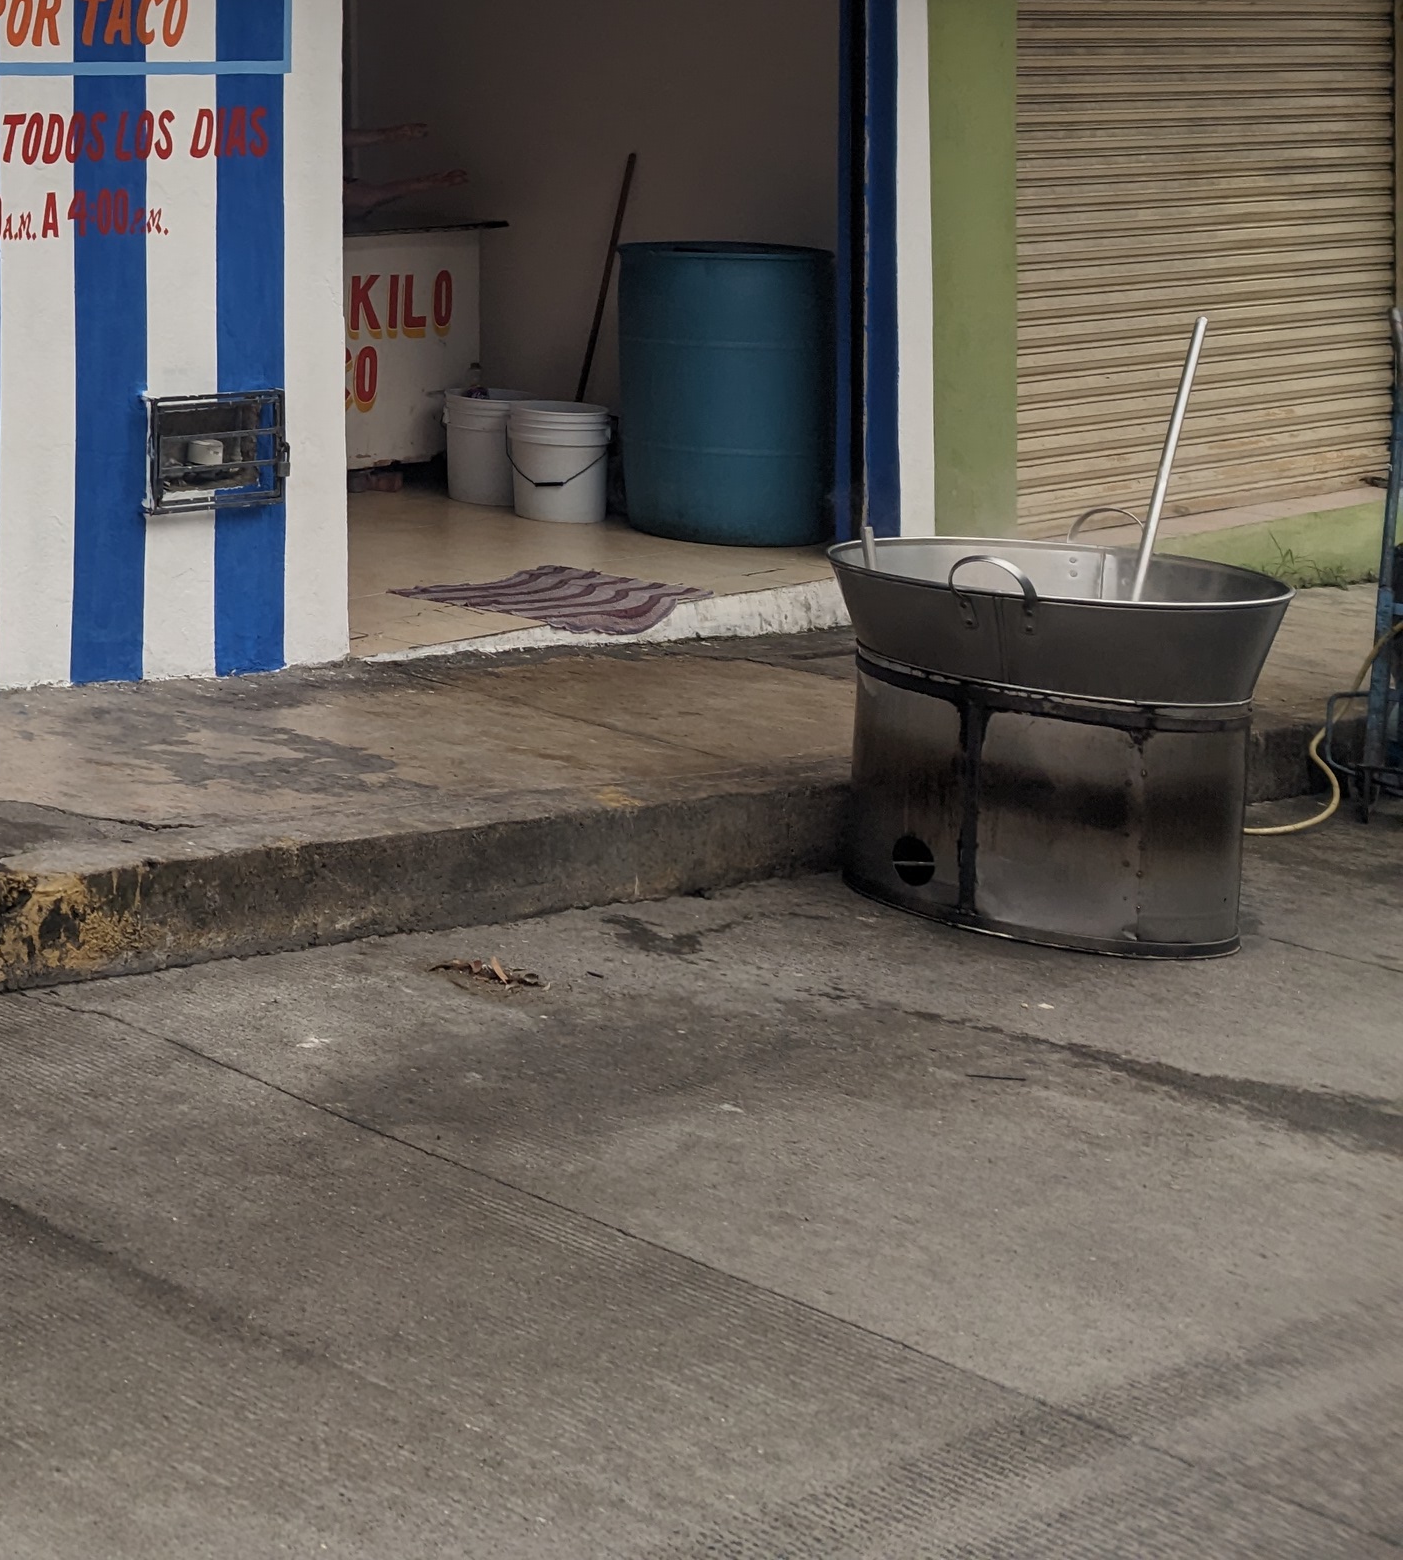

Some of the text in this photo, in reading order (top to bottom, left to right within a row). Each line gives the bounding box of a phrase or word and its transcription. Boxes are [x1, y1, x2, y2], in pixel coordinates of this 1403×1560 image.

[2, 111, 107, 165] TODOS
[114, 110, 176, 161] LOS
[189, 106, 268, 159] DIAS
[42, 192, 59, 239] A
[349, 270, 453, 336] KILO
